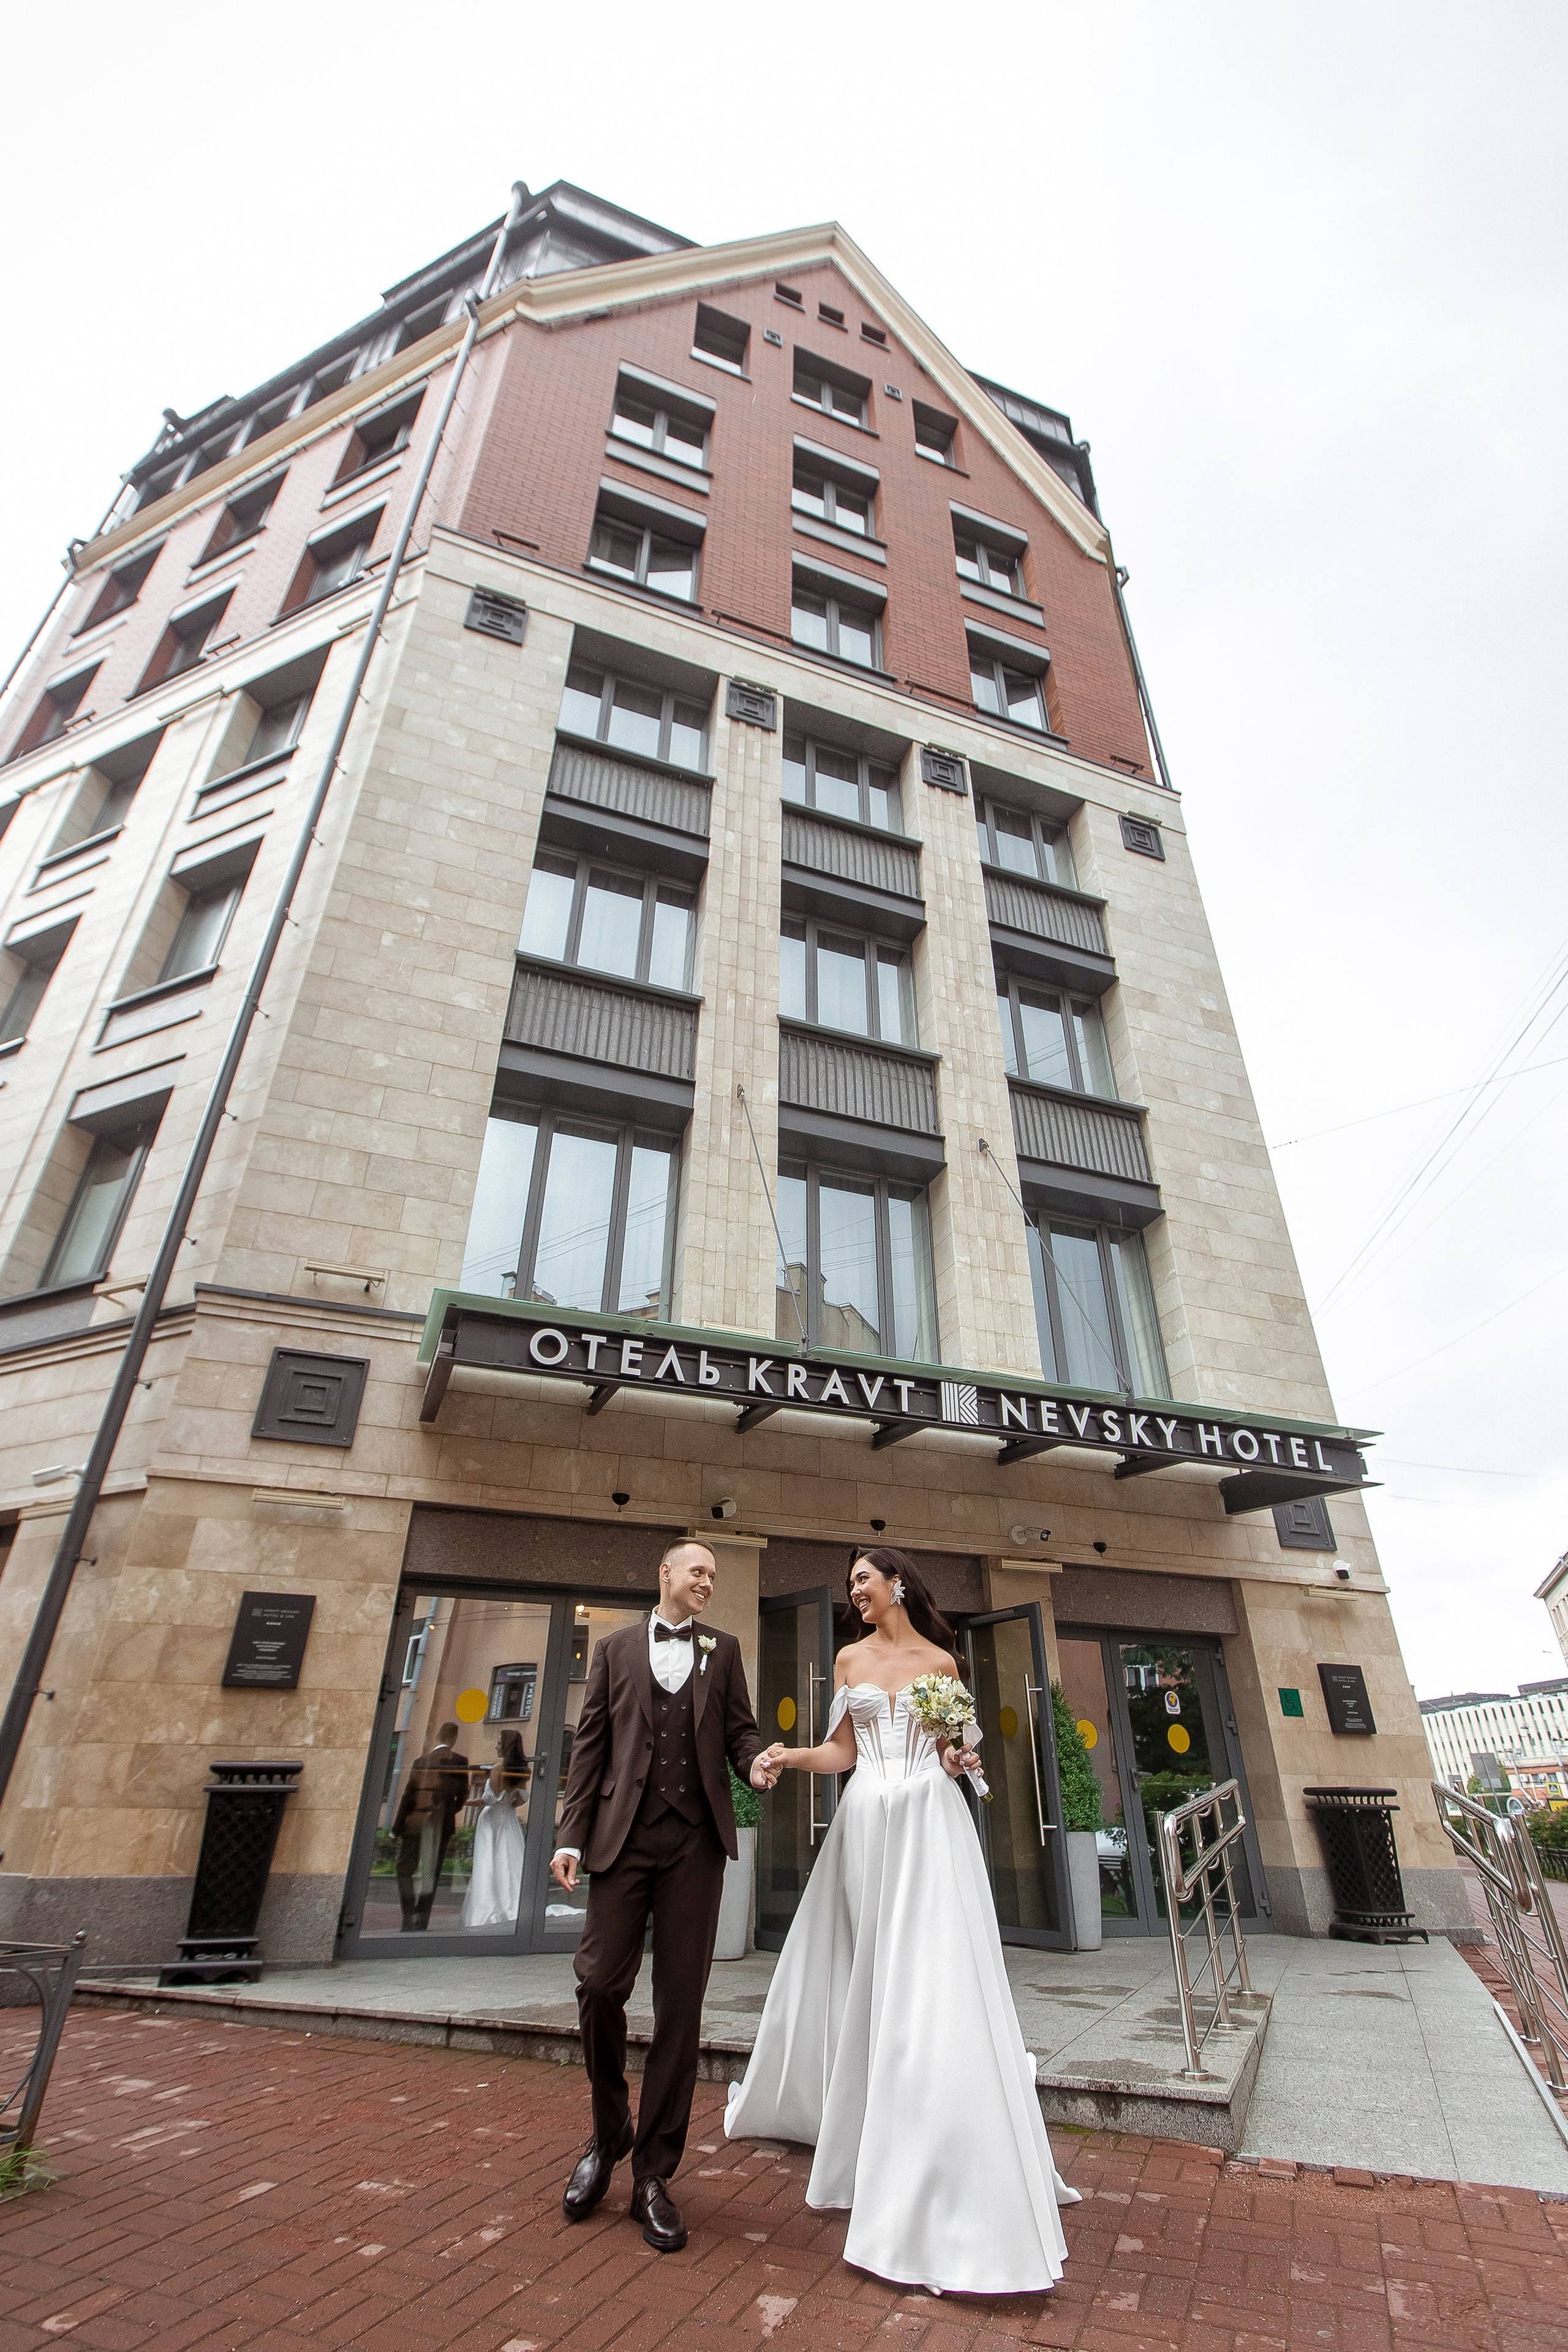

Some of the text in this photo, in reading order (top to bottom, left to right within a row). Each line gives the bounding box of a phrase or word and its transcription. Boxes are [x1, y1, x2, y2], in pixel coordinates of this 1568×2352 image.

[530, 1328, 914, 1412] ОТЕЛЬ KRAVT
[1000, 1393, 1333, 1471] NEVSKY HOTEL
